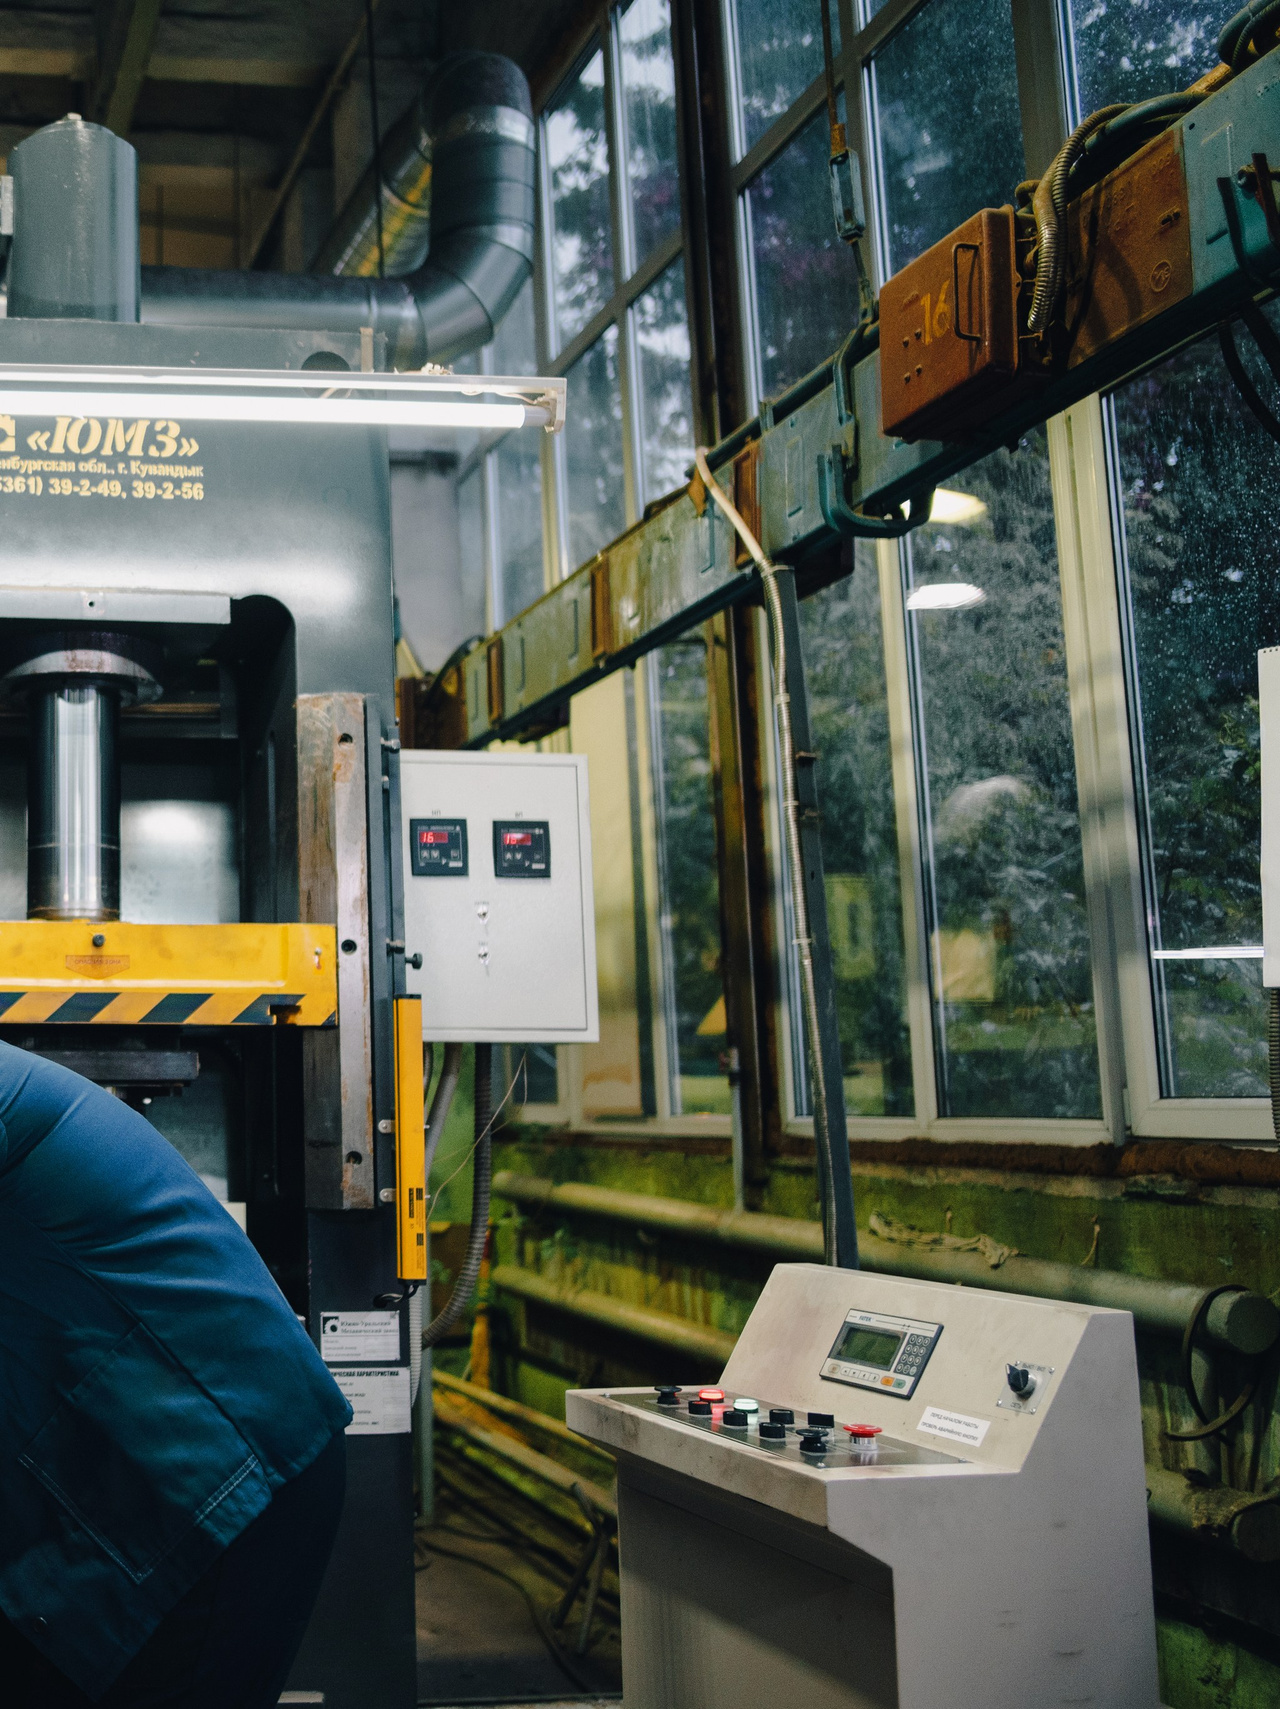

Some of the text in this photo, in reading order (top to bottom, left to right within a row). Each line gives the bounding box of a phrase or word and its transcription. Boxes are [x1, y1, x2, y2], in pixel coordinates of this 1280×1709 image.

[920, 277, 951, 345] 16
[27, 416, 200, 458] «ЮМЗ»
[117, 461, 128, 475] г.
[130, 460, 204, 479] Кувандык
[49, 477, 127, 499] 39-2-49,
[132, 480, 205, 500] 39-2-56
[423, 832, 434, 843] 16
